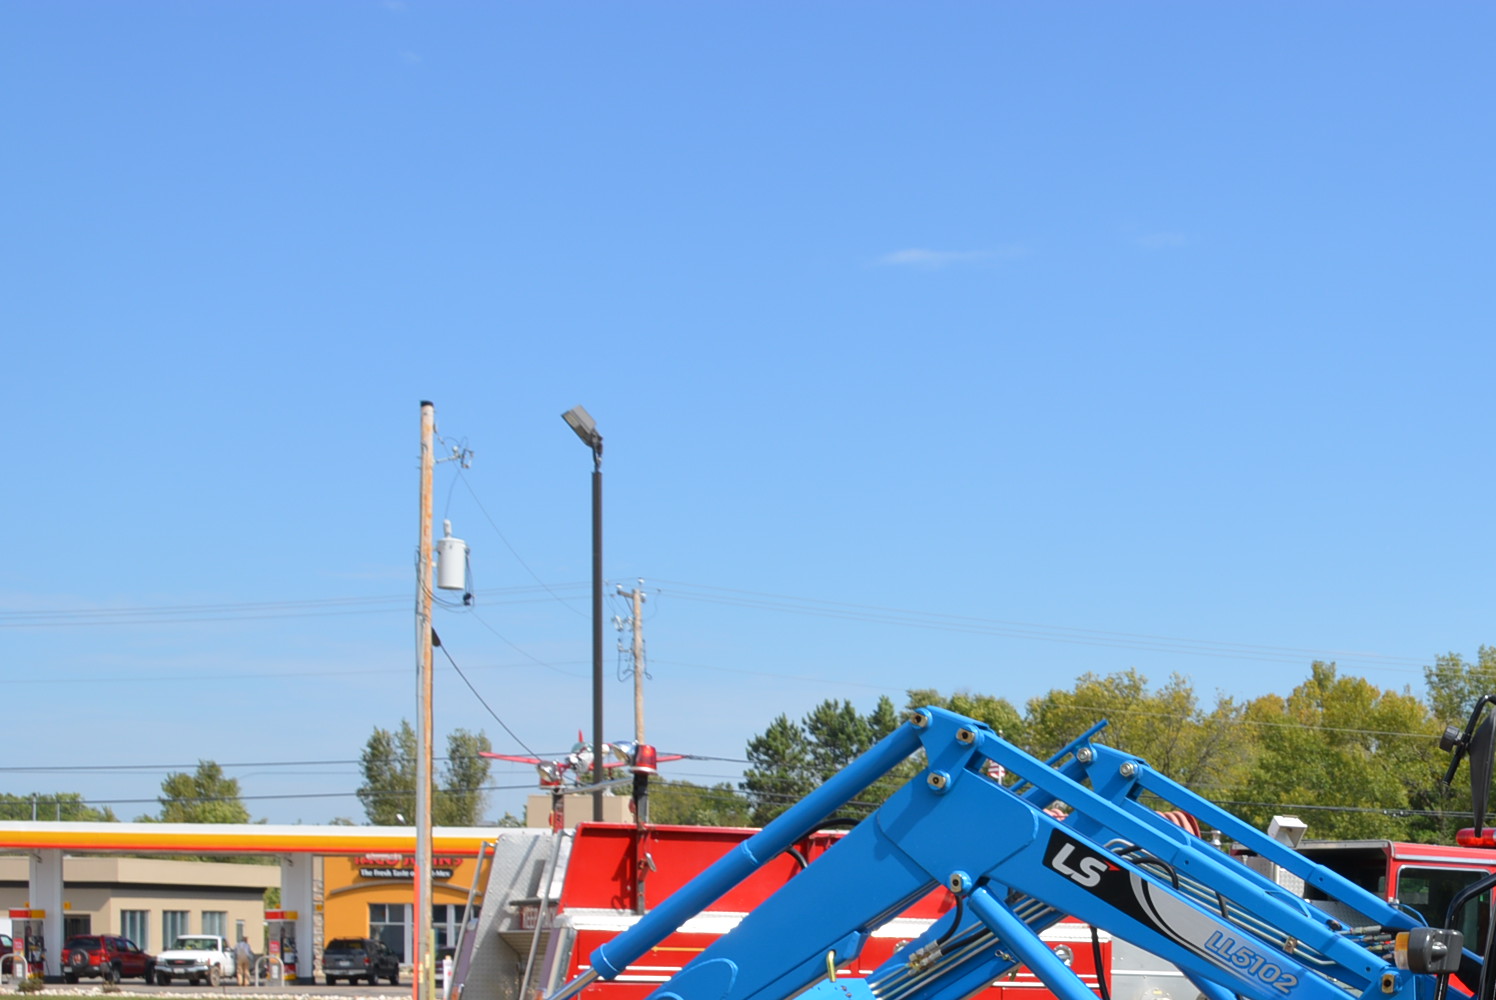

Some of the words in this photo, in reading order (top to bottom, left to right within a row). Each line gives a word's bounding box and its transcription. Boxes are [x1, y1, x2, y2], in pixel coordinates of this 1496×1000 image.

[360, 869, 373, 877] The
[1052, 842, 1108, 888] LS
[1204, 930, 1298, 995] LL5102
